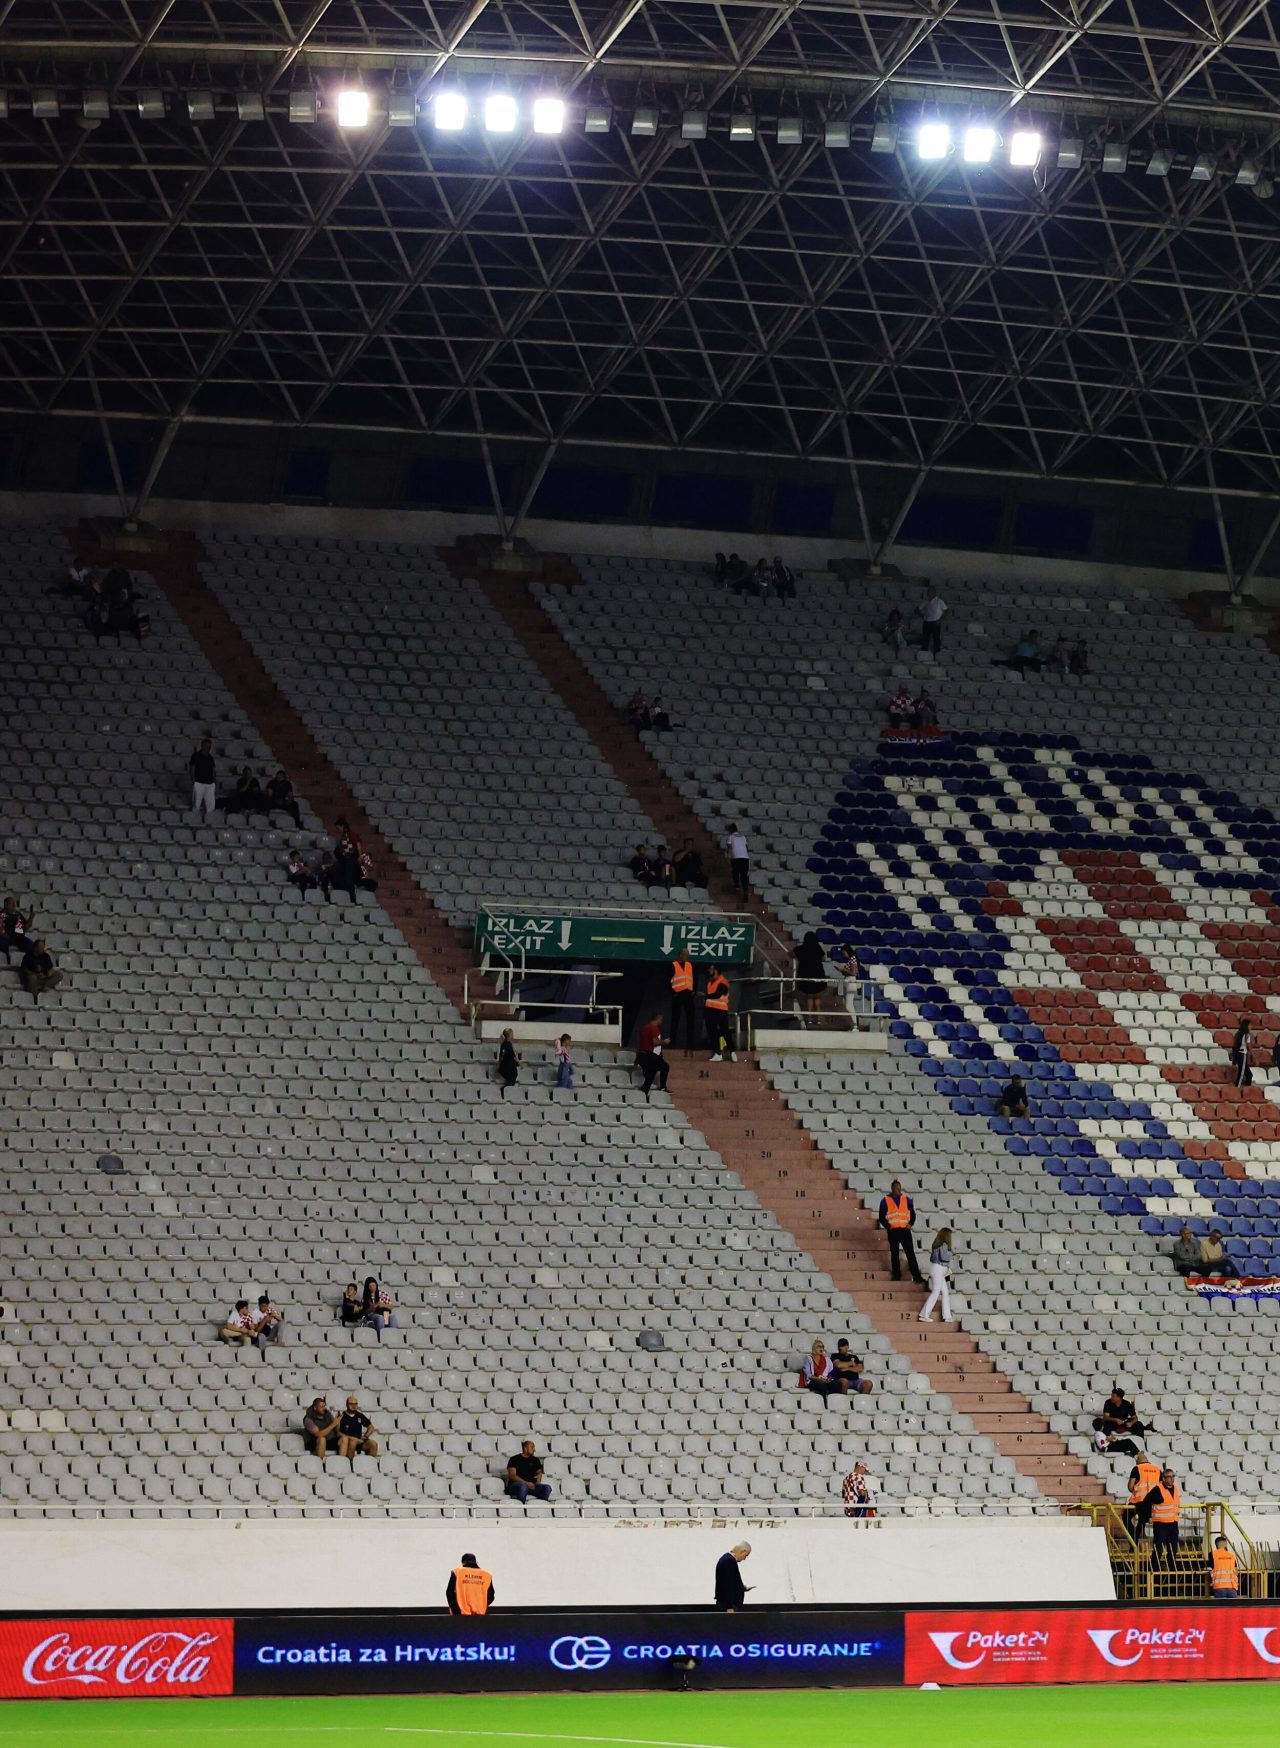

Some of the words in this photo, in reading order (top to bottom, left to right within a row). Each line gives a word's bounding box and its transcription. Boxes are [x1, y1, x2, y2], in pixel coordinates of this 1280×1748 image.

[487, 917, 554, 933] IZLAZ
[680, 925, 746, 940] IZLAZ
[493, 935, 545, 950] EXIT
[687, 942, 737, 957] EXIT
[23, 1632, 220, 1685] Coca-Cola
[257, 1643, 352, 1664] Croatia
[359, 1648, 388, 1663] za
[395, 1643, 516, 1662] Hrvatsku!
[623, 1645, 723, 1659] CROATIA
[730, 1642, 872, 1658] OSIGURANJE
